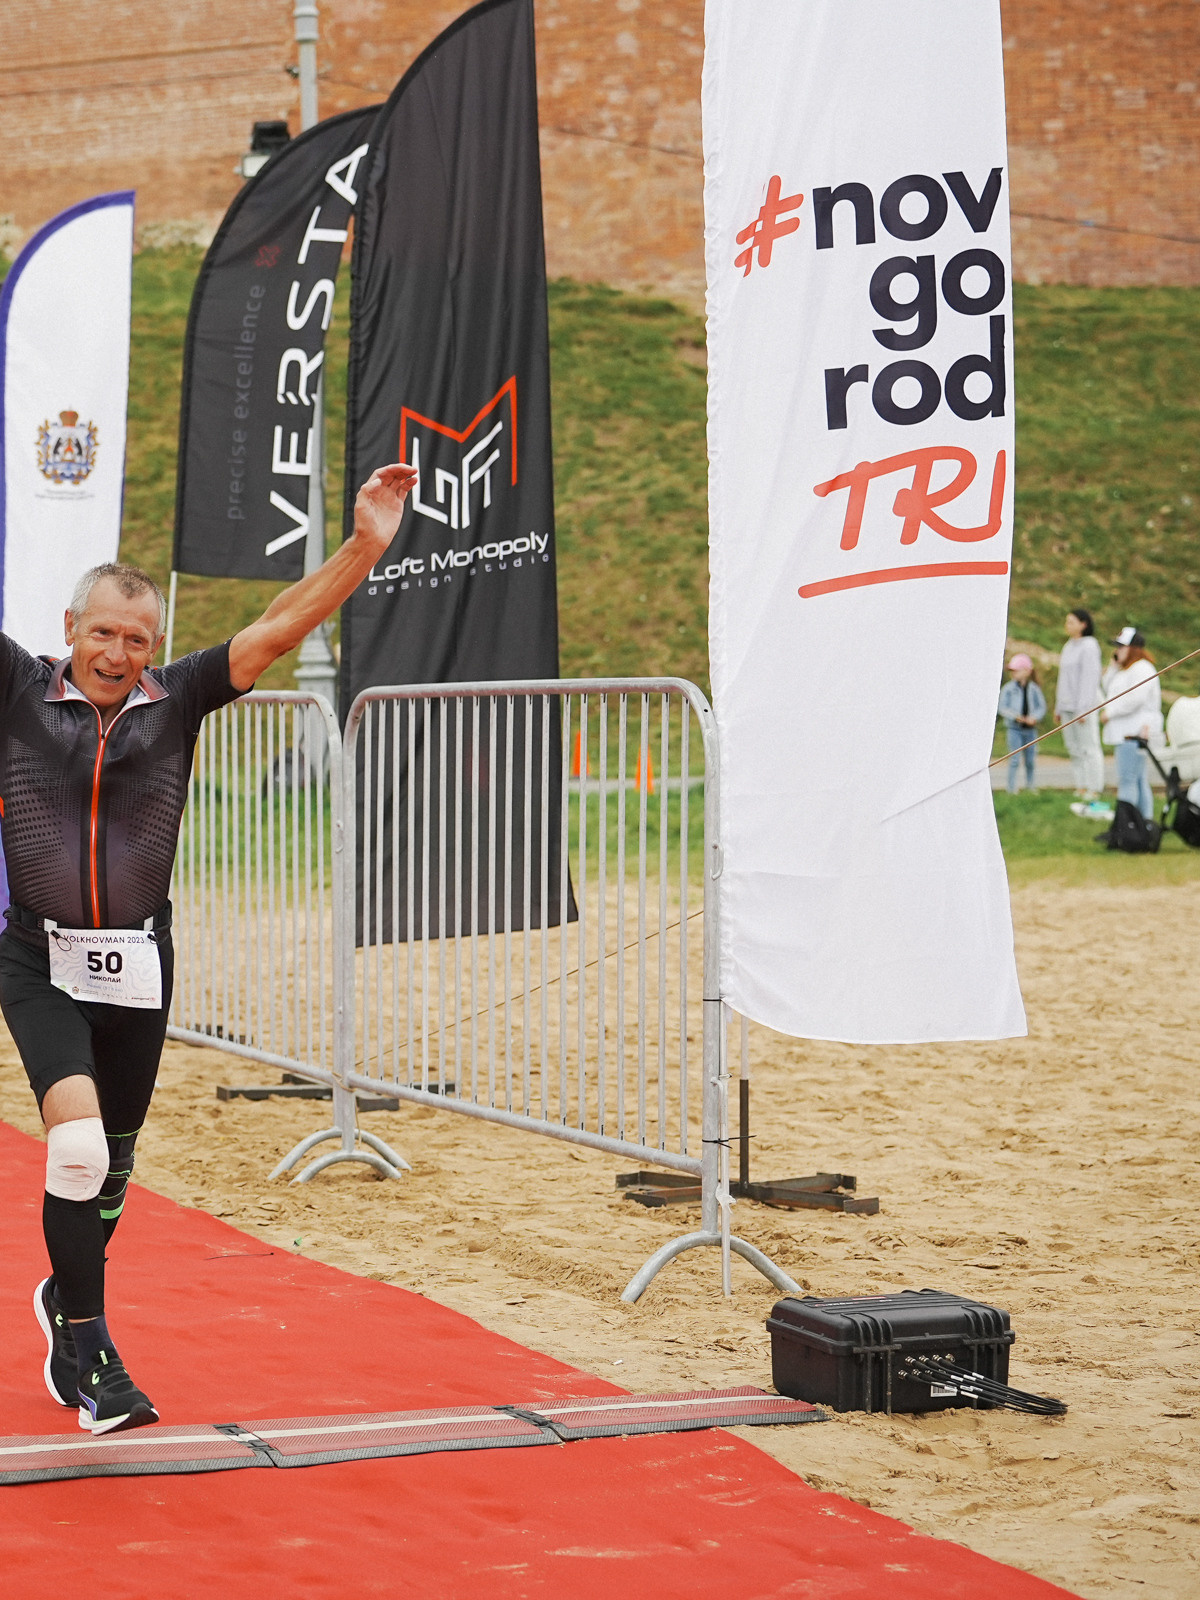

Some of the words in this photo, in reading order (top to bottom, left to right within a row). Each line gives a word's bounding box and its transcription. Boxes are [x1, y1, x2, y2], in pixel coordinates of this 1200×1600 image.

[734, 167, 1004, 277] #nov
[869, 248, 1006, 351] go
[234, 284, 267, 420] excellence
[265, 143, 370, 557] VERSTA
[824, 314, 1006, 430] rod
[227, 429, 248, 520] precise
[812, 446, 1007, 551] TRI
[368, 556, 425, 582] Loft
[430, 531, 549, 572] Monopoly
[368, 574, 452, 596] design
[469, 553, 550, 576] studio
[63, 934, 125, 944] VOLKHOVMAN
[127, 935, 145, 944] 2023
[87, 951, 123, 974] 50
[89, 974, 121, 983] НИКОЛАЙ
